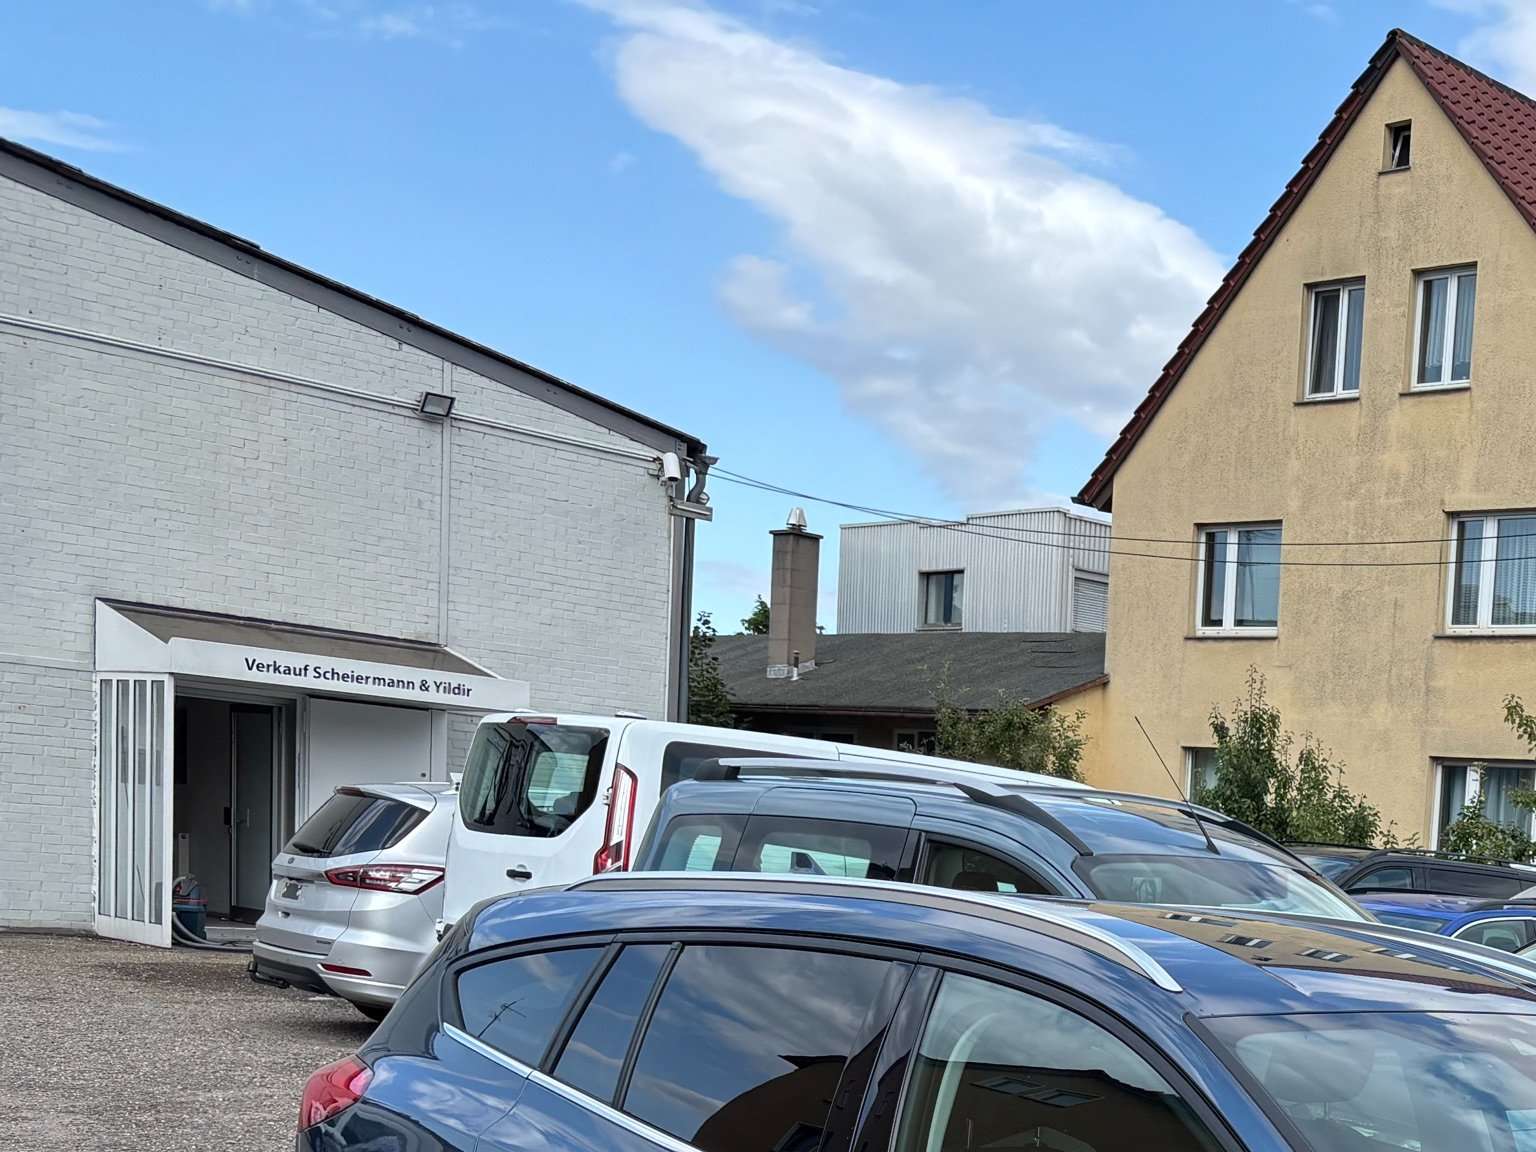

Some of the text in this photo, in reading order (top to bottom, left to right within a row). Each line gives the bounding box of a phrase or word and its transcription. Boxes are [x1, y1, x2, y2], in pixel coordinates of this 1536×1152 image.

[245, 657, 473, 697] Verkauf Scheiermann & Yildir
